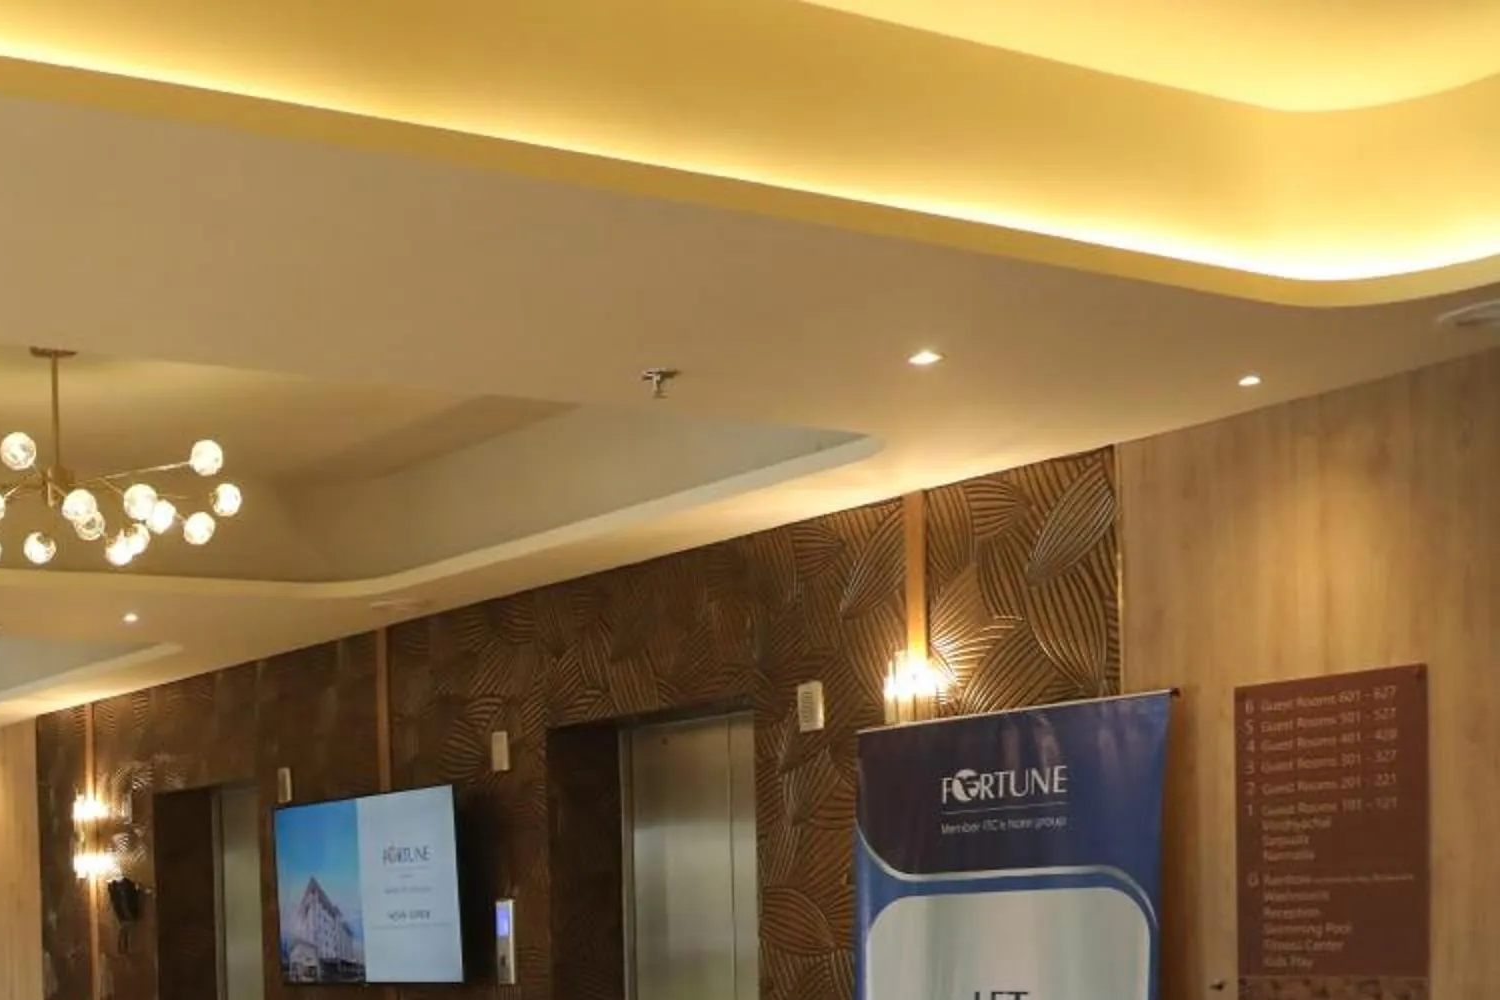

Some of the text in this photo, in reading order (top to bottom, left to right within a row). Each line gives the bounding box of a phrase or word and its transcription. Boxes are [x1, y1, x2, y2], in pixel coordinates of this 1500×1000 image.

[1296, 694, 1337, 707] Rooms
[1244, 719, 1255, 735] 5
[1297, 716, 1337, 728] Rooms
[1245, 739, 1255, 753] 4
[1297, 736, 1336, 749] Rooms
[1244, 759, 1255, 775] 3
[1297, 757, 1337, 769] Rooms
[941, 765, 1068, 804] FORTUNE
[1244, 781, 1255, 796] 2
[1297, 780, 1337, 792] Rooms
[1245, 804, 1253, 817] 1
[1297, 801, 1337, 813] Rooms
[383, 844, 432, 867] FORTUNE
[1263, 906, 1322, 920] Reception
[1325, 921, 1353, 935] Pool
